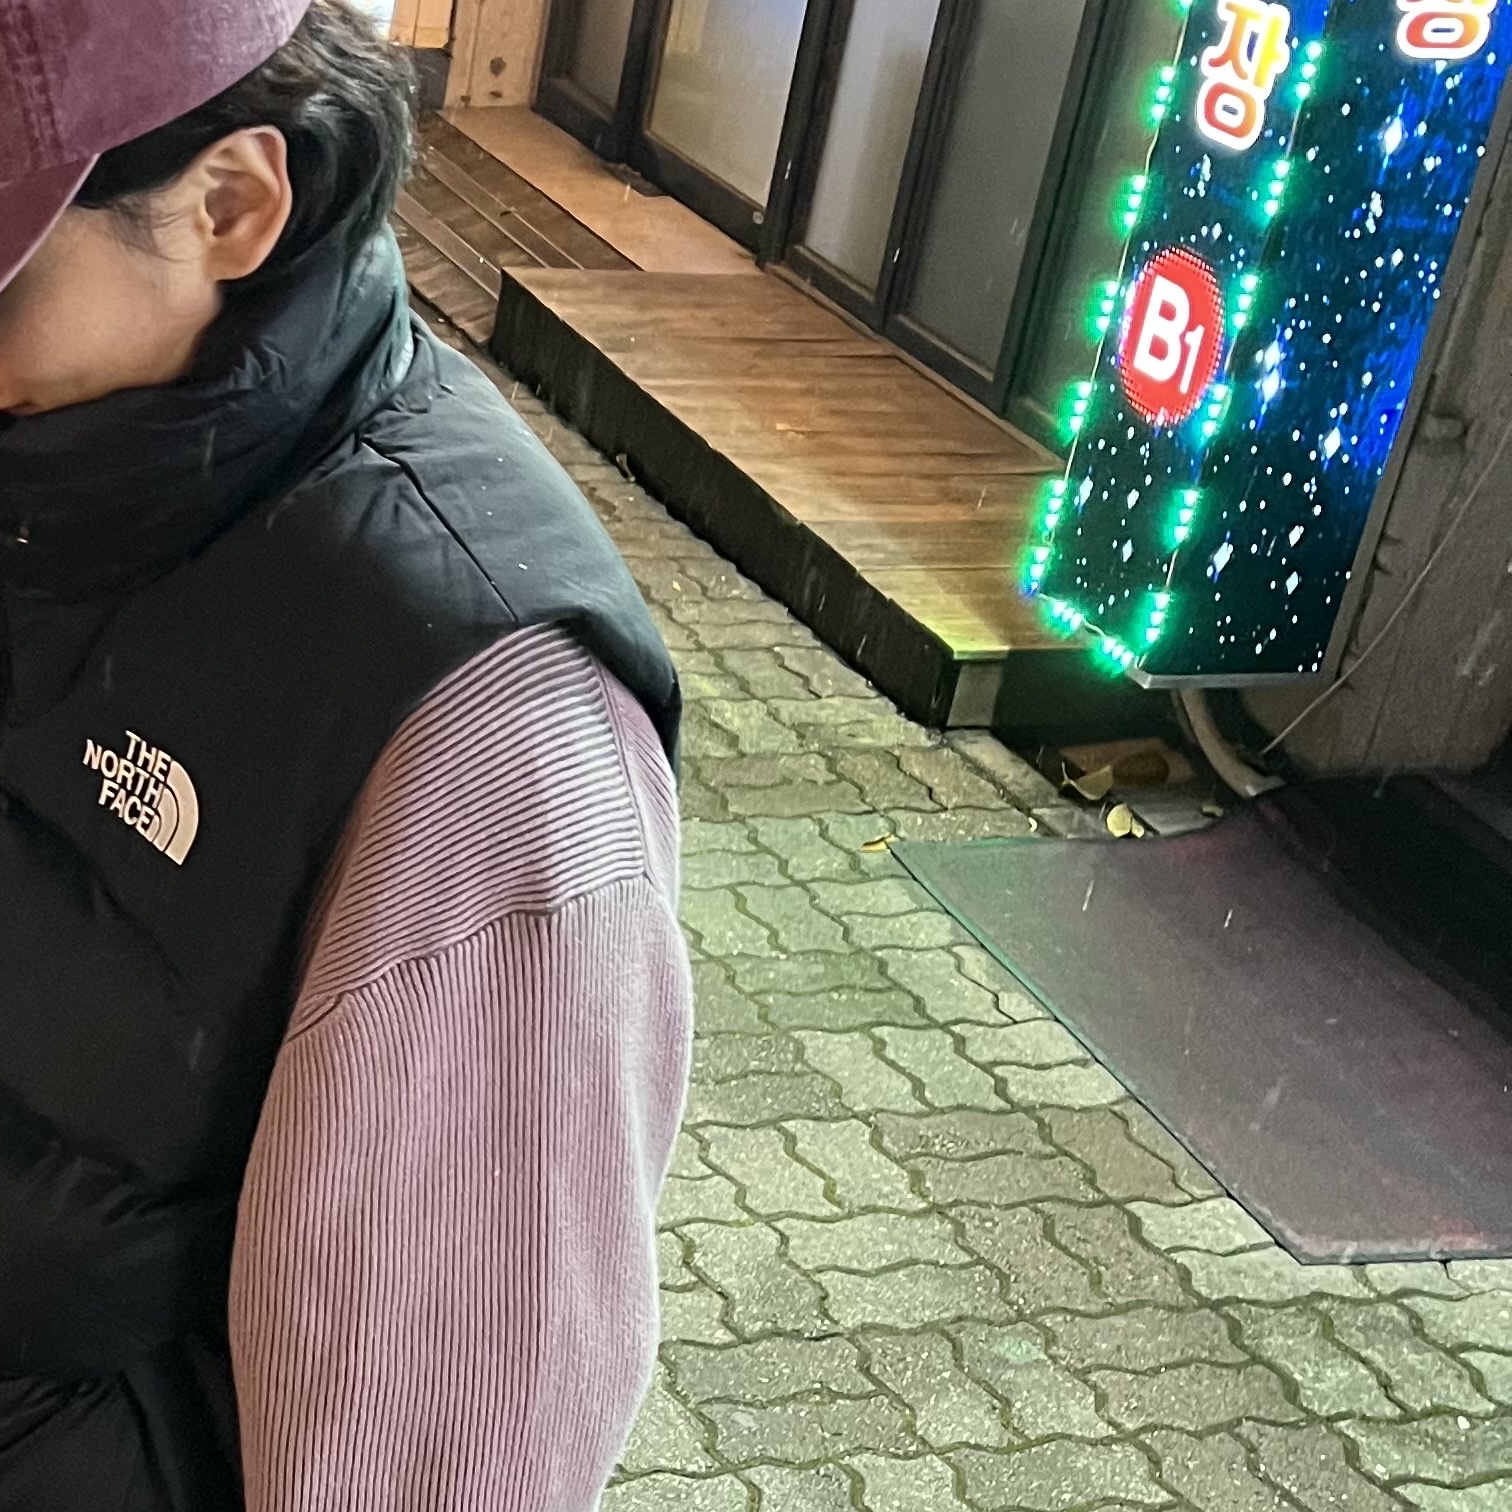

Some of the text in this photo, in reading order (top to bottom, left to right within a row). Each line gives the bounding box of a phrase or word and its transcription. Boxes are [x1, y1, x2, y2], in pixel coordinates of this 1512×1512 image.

[1198, 0, 1289, 149] 장
[1133, 274, 1205, 394] B1
[82, 738, 165, 810] NORTH
[125, 730, 172, 782] THE
[98, 778, 156, 836] FACE
